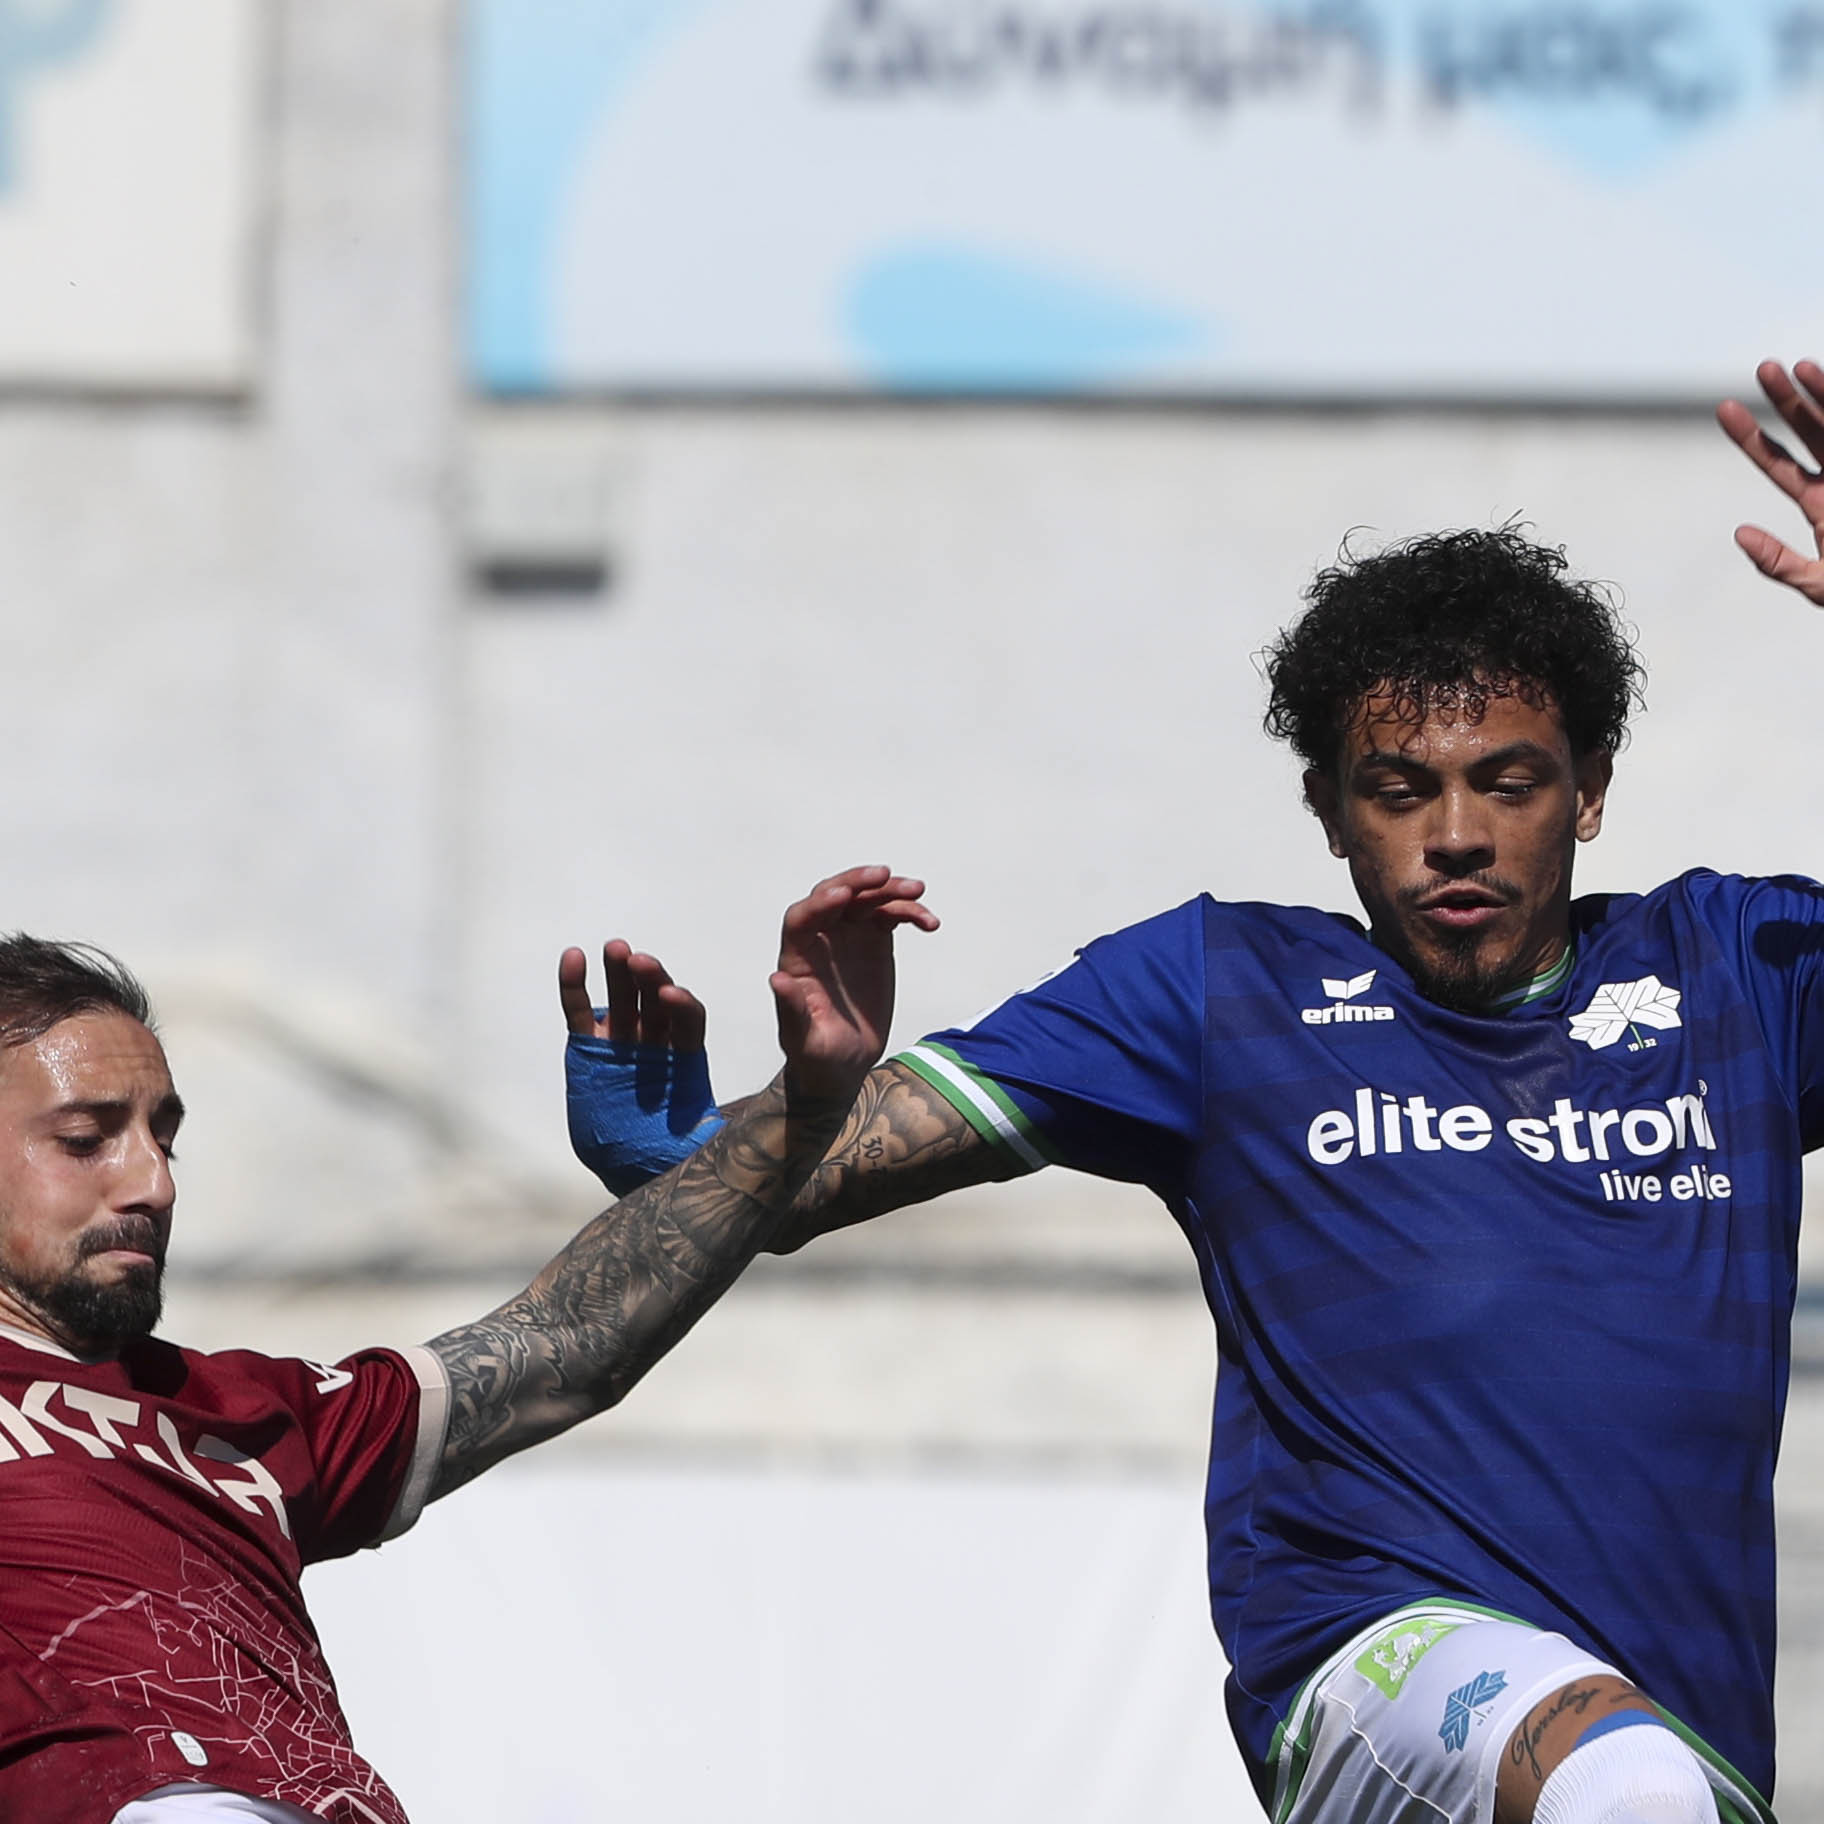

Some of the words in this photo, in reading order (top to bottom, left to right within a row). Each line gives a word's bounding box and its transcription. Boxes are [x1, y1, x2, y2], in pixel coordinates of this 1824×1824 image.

[1301, 1001, 1395, 1025] erima
[1307, 1087, 1492, 1165] elite
[1599, 1169, 1662, 1201] live
